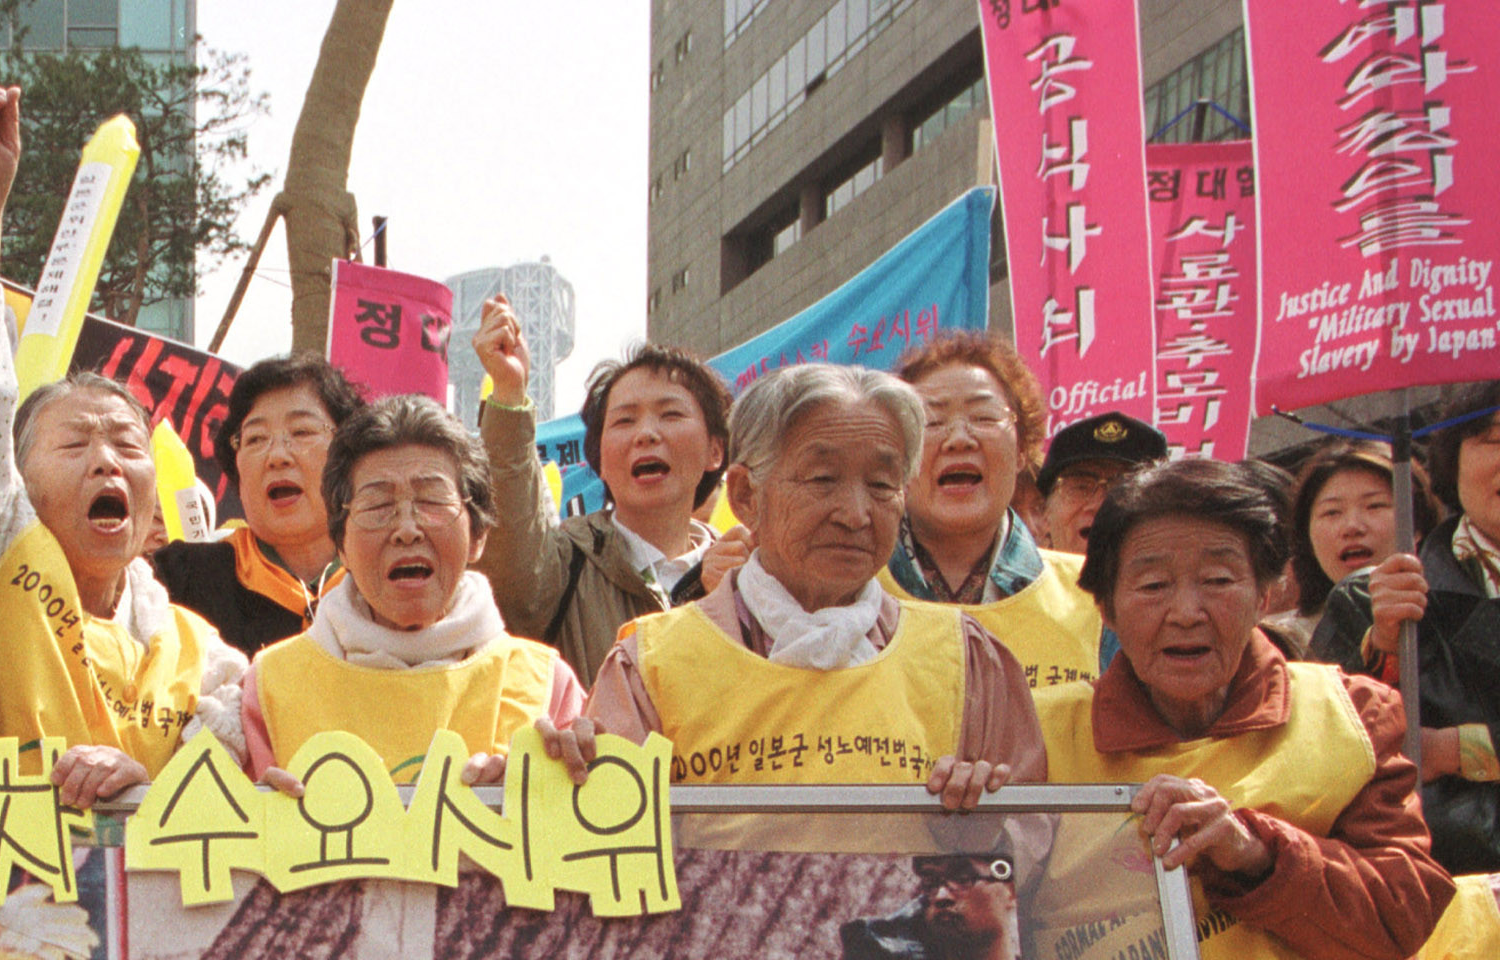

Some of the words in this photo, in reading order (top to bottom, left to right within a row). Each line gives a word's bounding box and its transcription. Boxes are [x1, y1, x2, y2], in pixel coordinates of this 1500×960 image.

[1276, 281, 1351, 321] Justice
[1358, 258, 1398, 299] And
[1409, 257, 1492, 291] Dignity
[1419, 287, 1495, 321] Sexual
[1297, 338, 1380, 378] Slavery
[1390, 322, 1419, 363] by
[1049, 370, 1147, 416] Official
[749, 733, 809, 771] 일본군
[817, 735, 907, 769] 성노예전범
